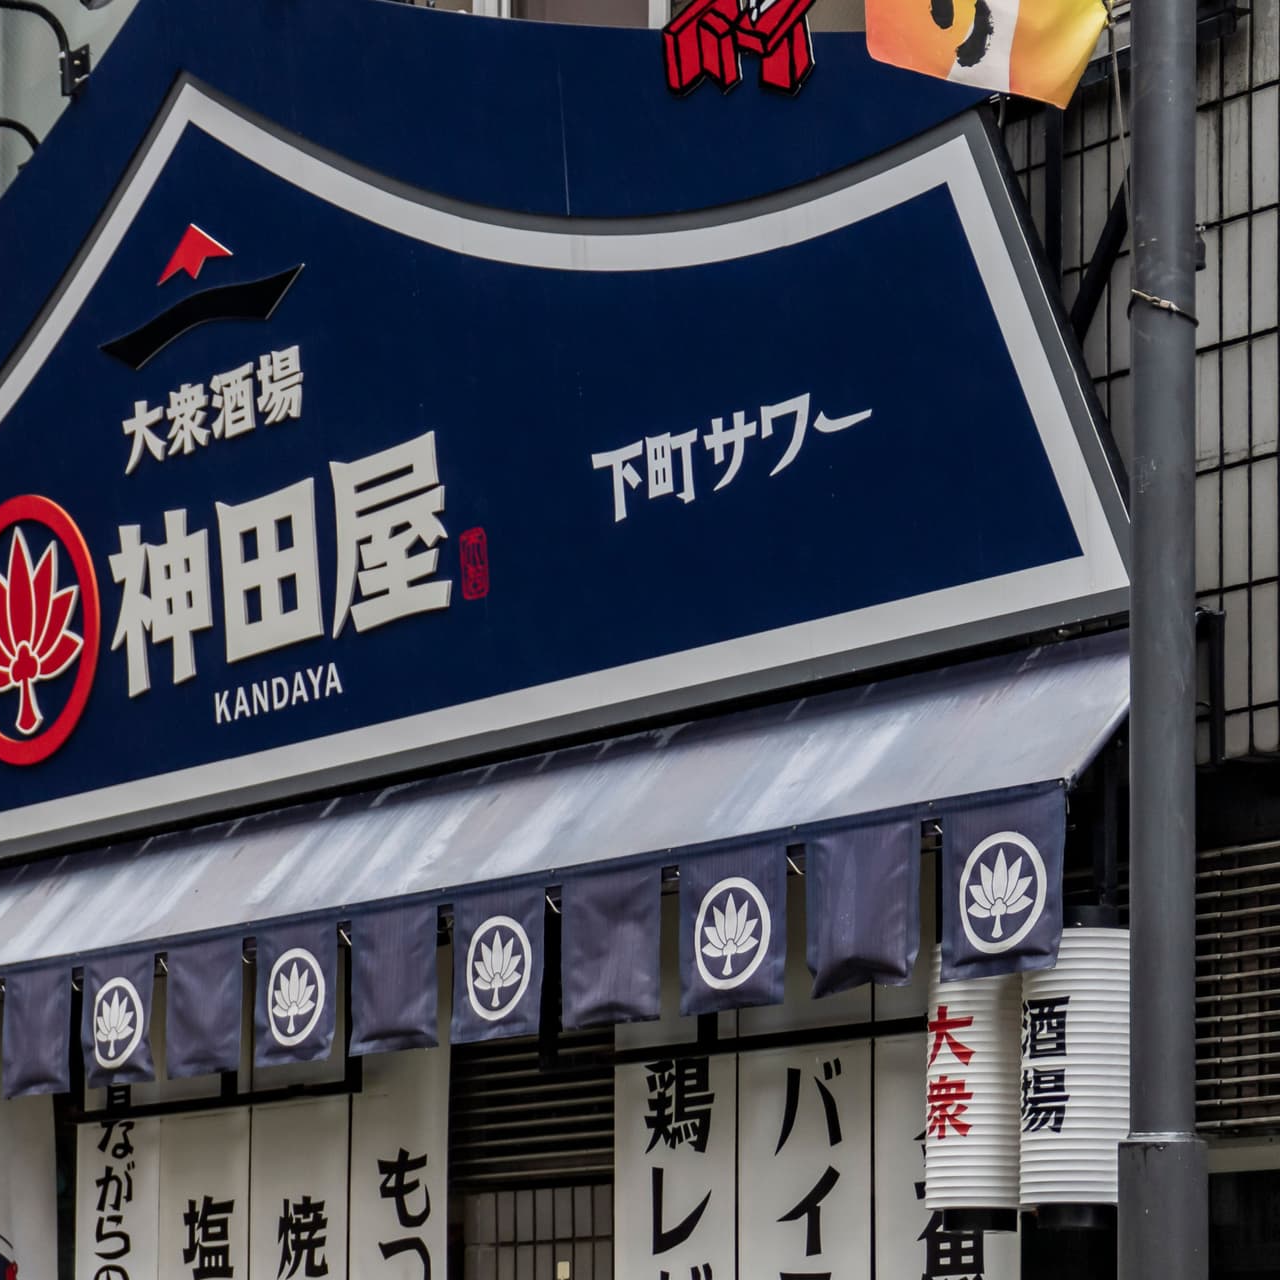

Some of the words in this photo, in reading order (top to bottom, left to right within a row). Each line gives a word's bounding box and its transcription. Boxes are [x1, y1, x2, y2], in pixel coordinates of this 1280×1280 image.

[120, 344, 304, 476] 大衆酒場
[591, 393, 872, 523] 下町サワー
[109, 430, 453, 699] 神田屋
[214, 662, 344, 725] KANDAYA
[927, 1005, 975, 1142] 大衆
[1020, 995, 1071, 1134] 酒場
